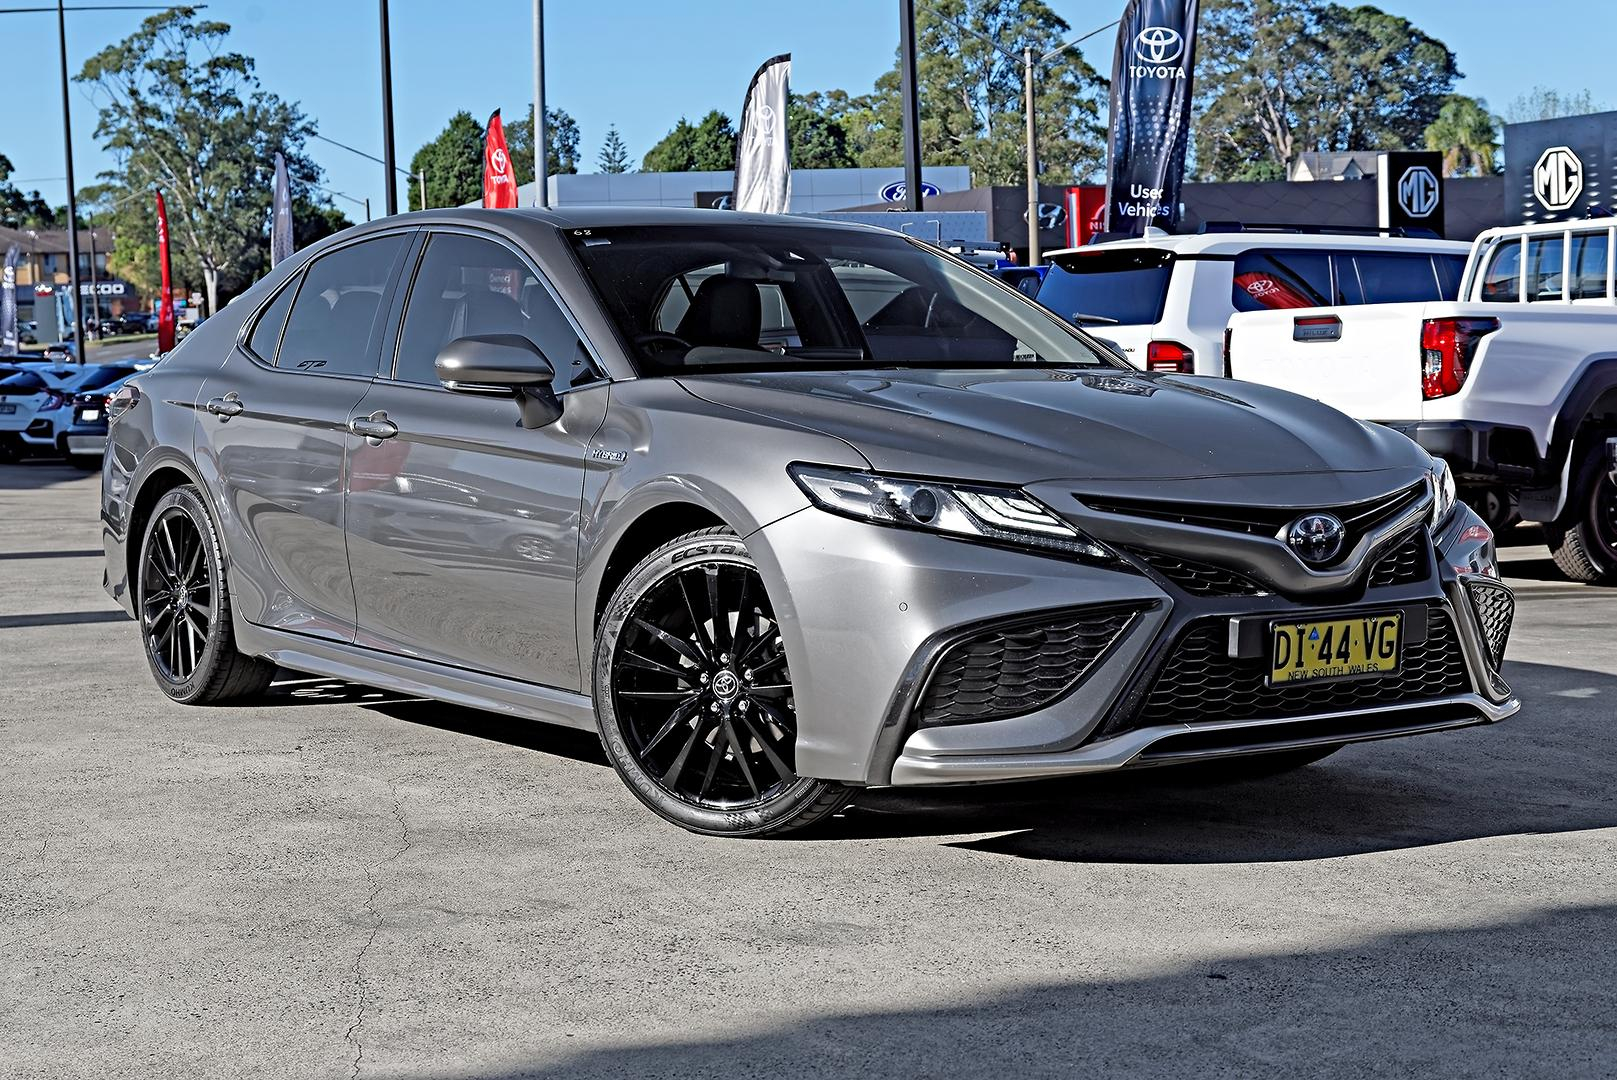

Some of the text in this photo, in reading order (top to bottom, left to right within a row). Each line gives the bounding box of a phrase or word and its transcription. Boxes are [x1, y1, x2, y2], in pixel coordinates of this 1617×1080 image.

[1129, 65, 1187, 79] TOYOTA
[1402, 169, 1436, 214] MG
[1536, 150, 1580, 207] MG
[1118, 202, 1170, 218] Vehices
[1318, 625, 1351, 665] 44
[1363, 619, 1396, 660] VG
[1288, 662, 1379, 681] NEW SOUTH WALES
